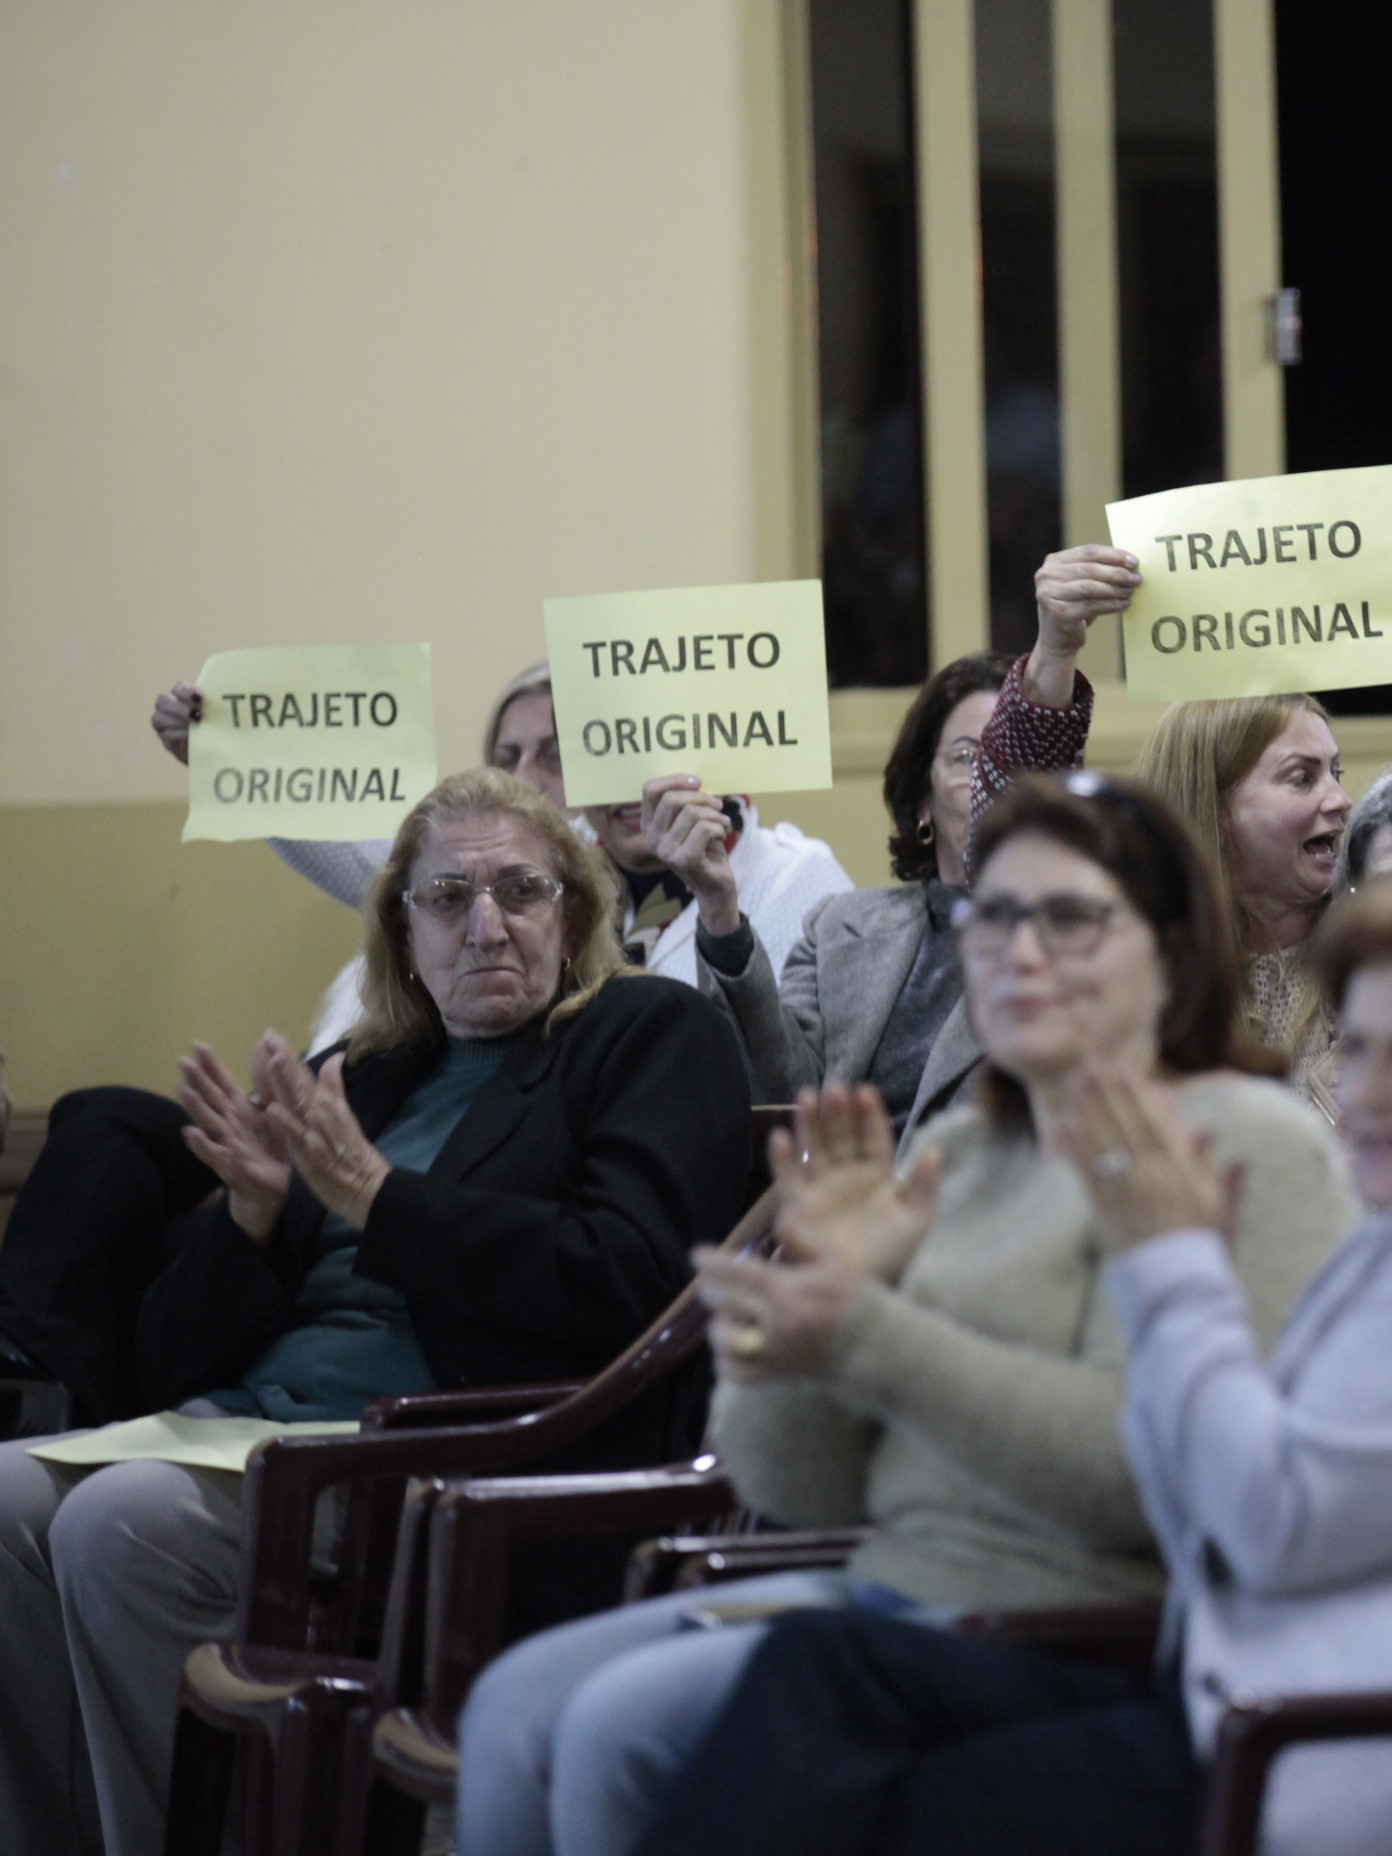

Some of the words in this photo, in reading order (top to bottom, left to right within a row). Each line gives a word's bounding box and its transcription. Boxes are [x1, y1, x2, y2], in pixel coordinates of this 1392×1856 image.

[1154, 519, 1362, 572] TRAJETO
[1150, 600, 1384, 654] ORIGINAL
[582, 631, 781, 678] TRAJETO
[222, 691, 398, 728] TRAJETO
[582, 709, 799, 757] ORIGINAL
[213, 767, 406, 804] ORIGINAL
